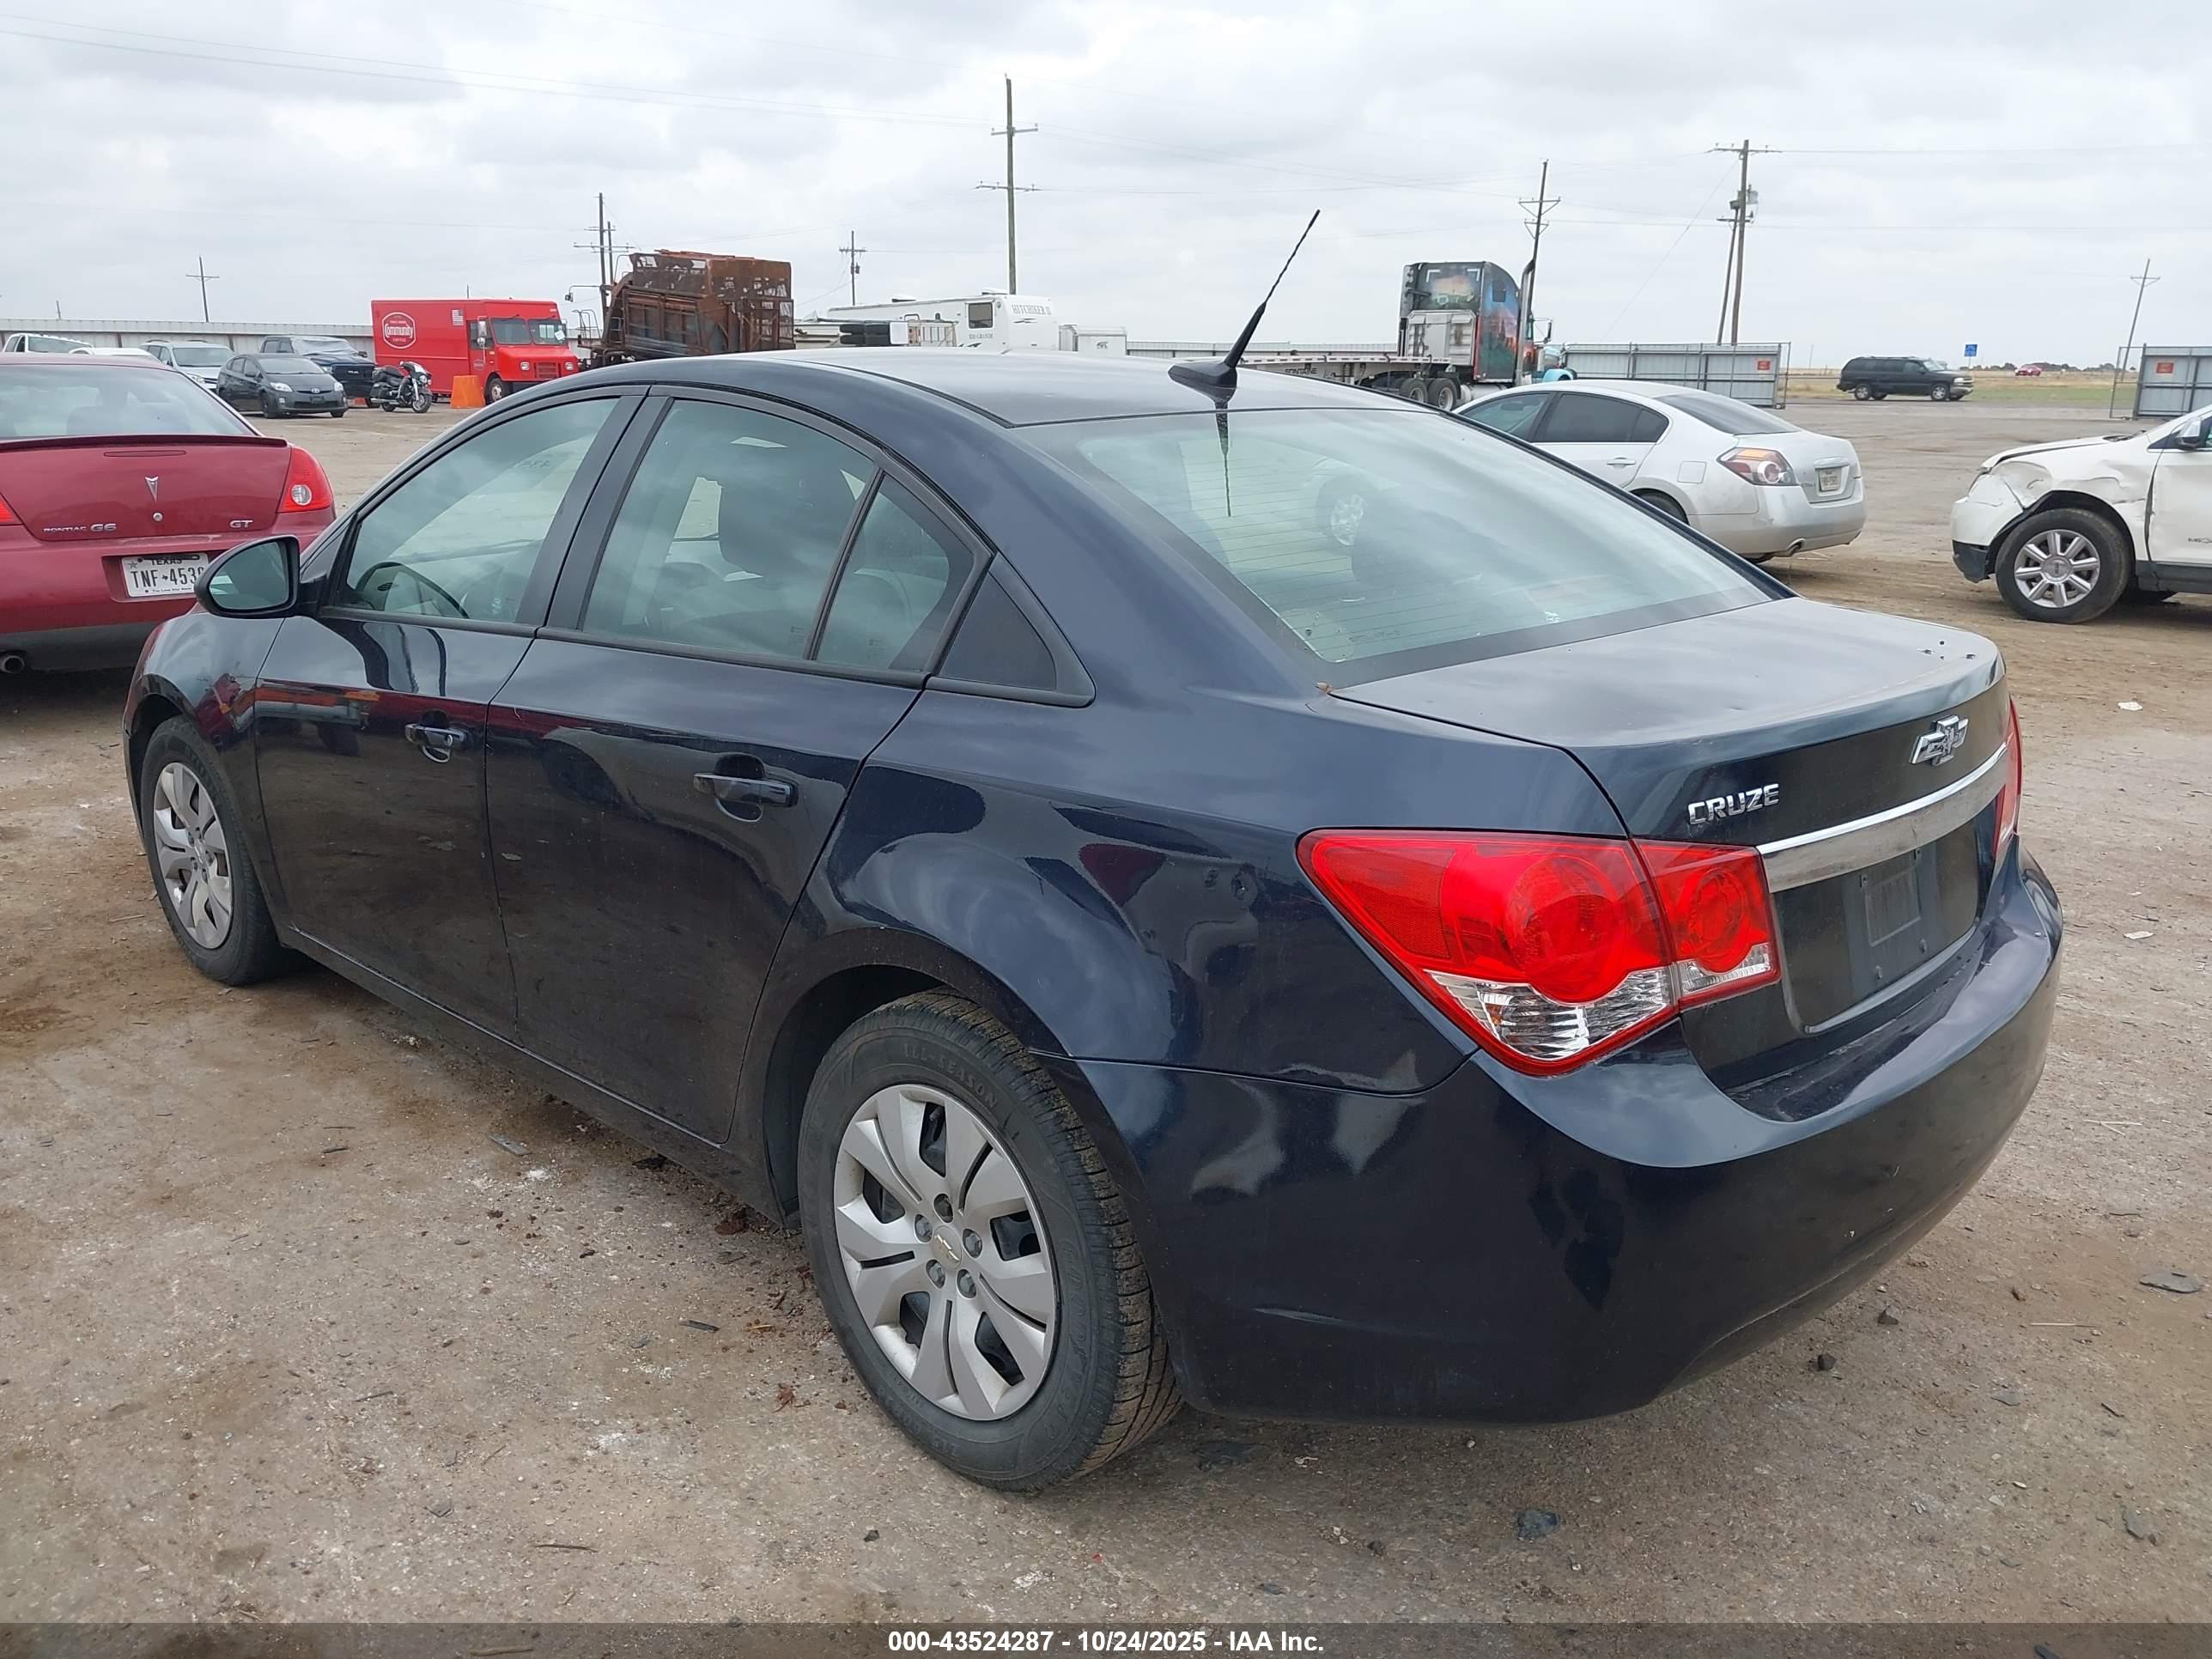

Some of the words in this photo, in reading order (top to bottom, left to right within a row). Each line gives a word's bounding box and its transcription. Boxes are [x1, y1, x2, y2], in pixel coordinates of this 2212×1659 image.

[90, 523, 117, 532] G6
[229, 520, 253, 528] GT
[131, 569, 158, 588] TNF
[1687, 783, 1779, 824] CRUZE
